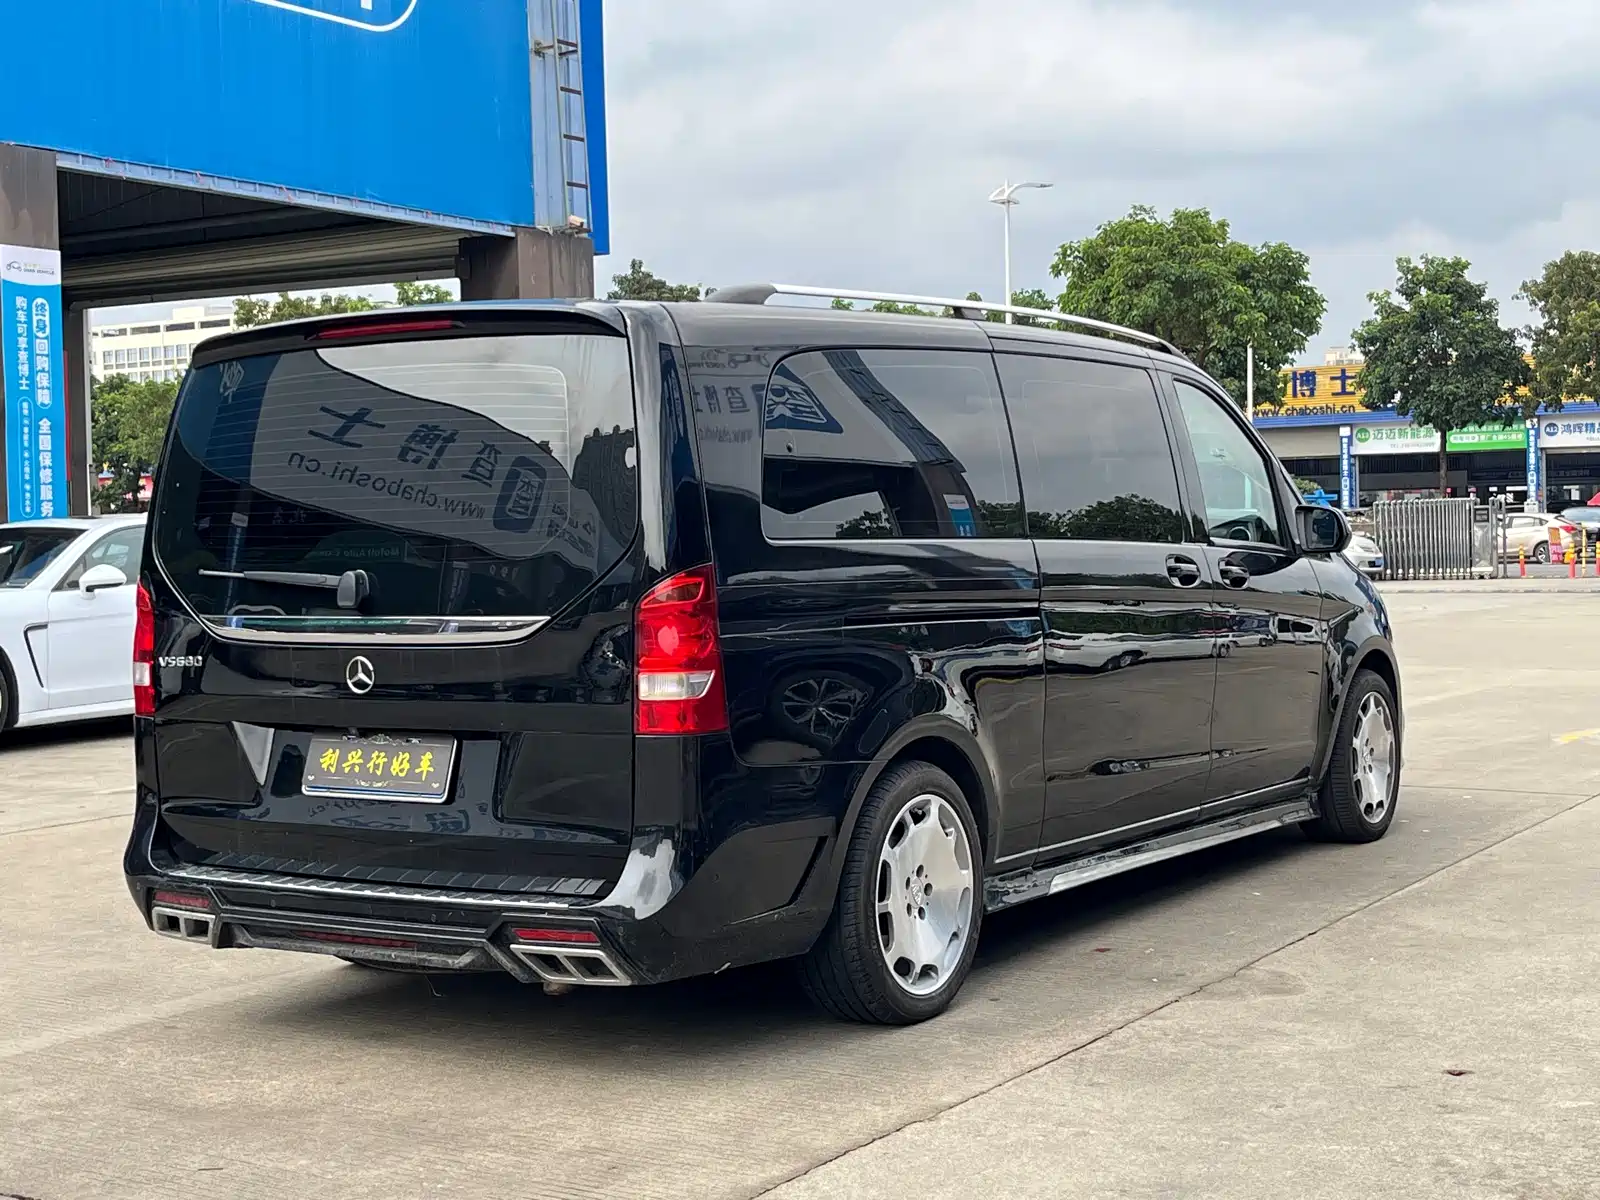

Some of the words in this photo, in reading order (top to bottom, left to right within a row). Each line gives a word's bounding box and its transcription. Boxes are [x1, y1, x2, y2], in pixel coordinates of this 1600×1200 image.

[1291, 368, 1357, 398] 博士
[1372, 427, 1434, 440] 迈迈新能源
[319, 748, 434, 782] 利兴行好车
